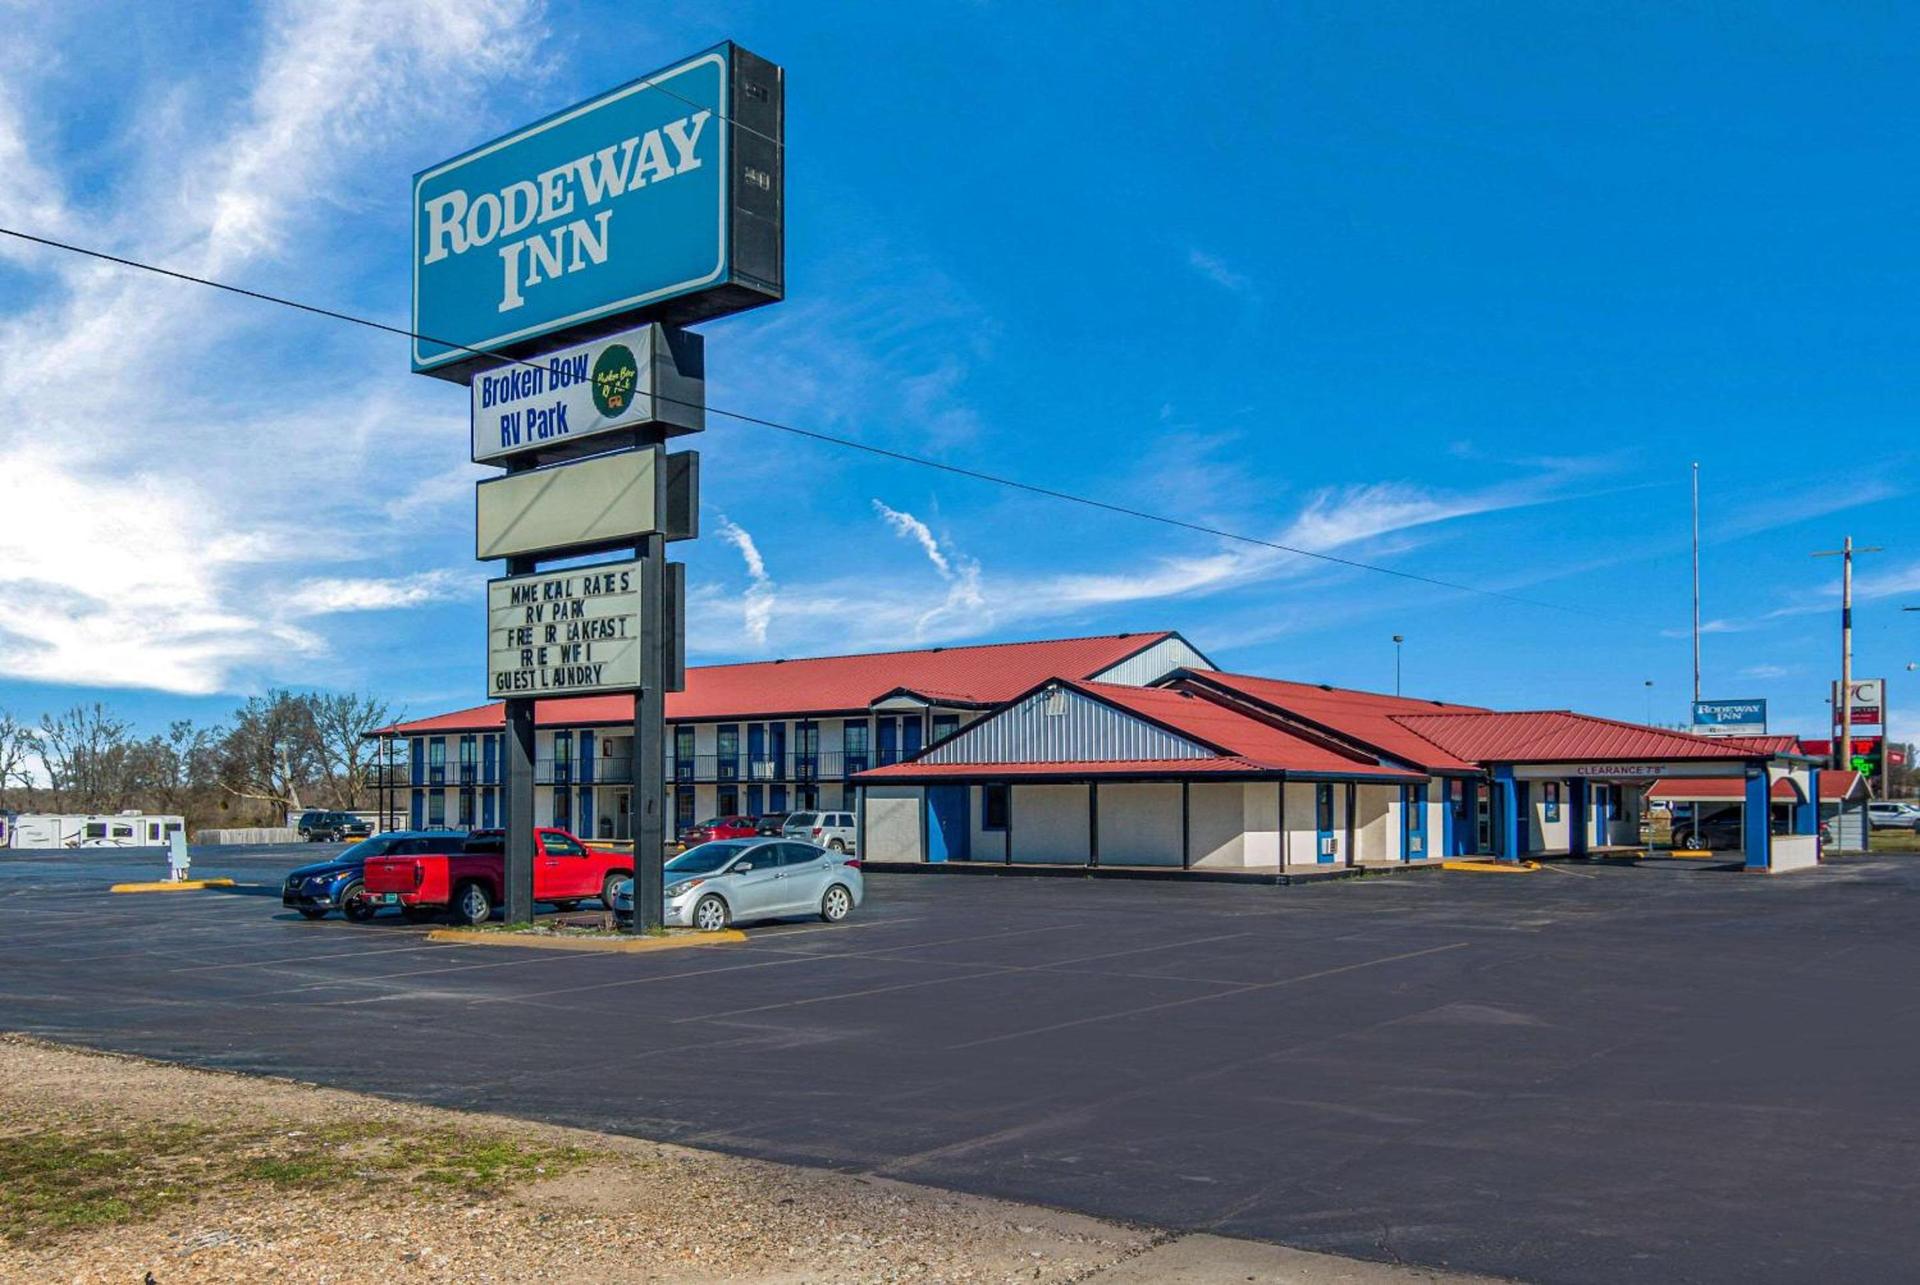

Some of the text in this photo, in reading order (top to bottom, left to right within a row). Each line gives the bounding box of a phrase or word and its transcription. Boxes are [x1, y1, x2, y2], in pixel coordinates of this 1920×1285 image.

[424, 108, 711, 265] RODEWAY
[498, 209, 613, 313] INN
[482, 367, 544, 409] Broken
[501, 401, 569, 448] RV Park
[526, 599, 586, 624] RV PARK
[496, 669, 535, 691] GUEST
[1717, 712, 1742, 722] INN
[1577, 765, 1643, 776] CLEARANCE
